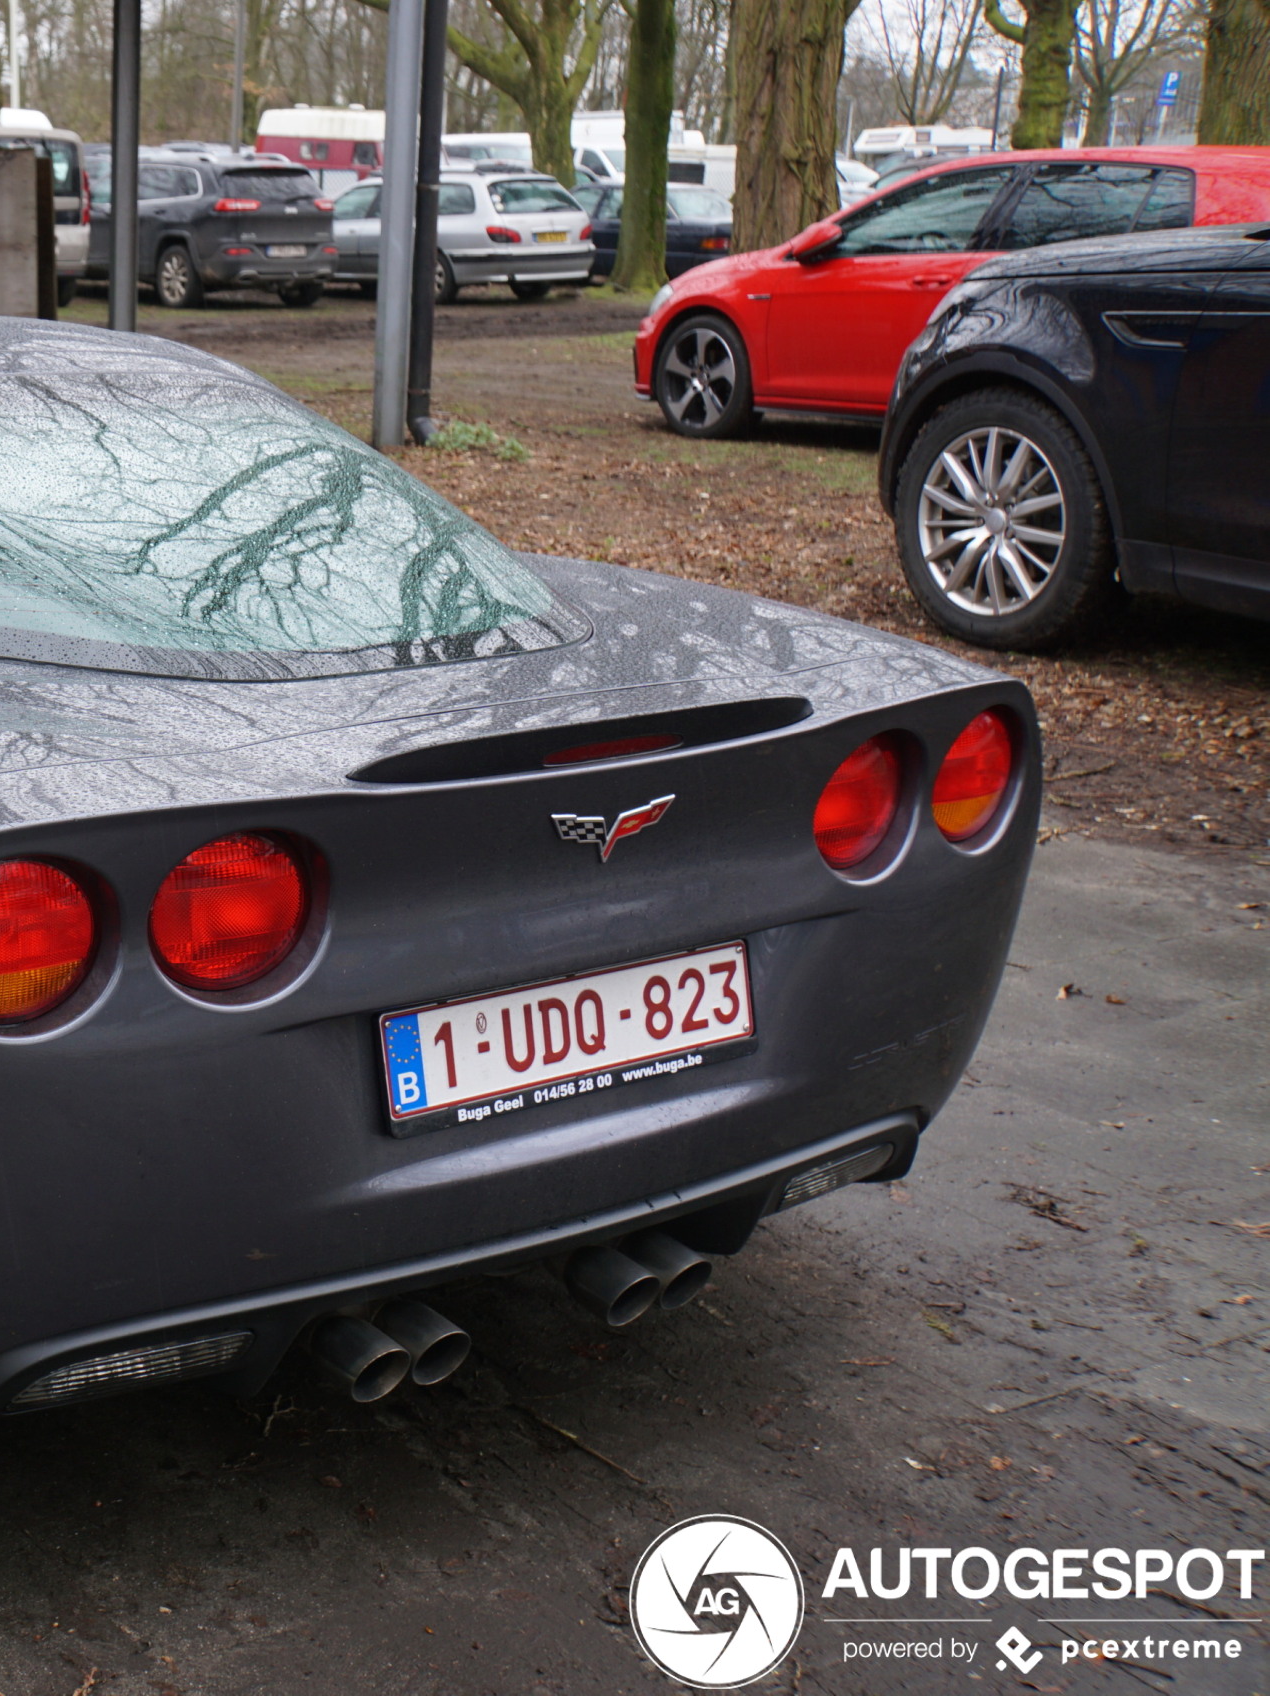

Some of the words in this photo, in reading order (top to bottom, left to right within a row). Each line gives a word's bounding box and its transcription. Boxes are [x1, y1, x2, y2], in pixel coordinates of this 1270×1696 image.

[397, 1070, 422, 1105] B
[457, 1105, 492, 1122] Buga
[493, 1095, 524, 1114] Geel
[533, 1080, 576, 1104] 014/56
[578, 1078, 595, 1093] 28
[596, 1073, 613, 1089] 00
[621, 1053, 703, 1082] www.buga.be
